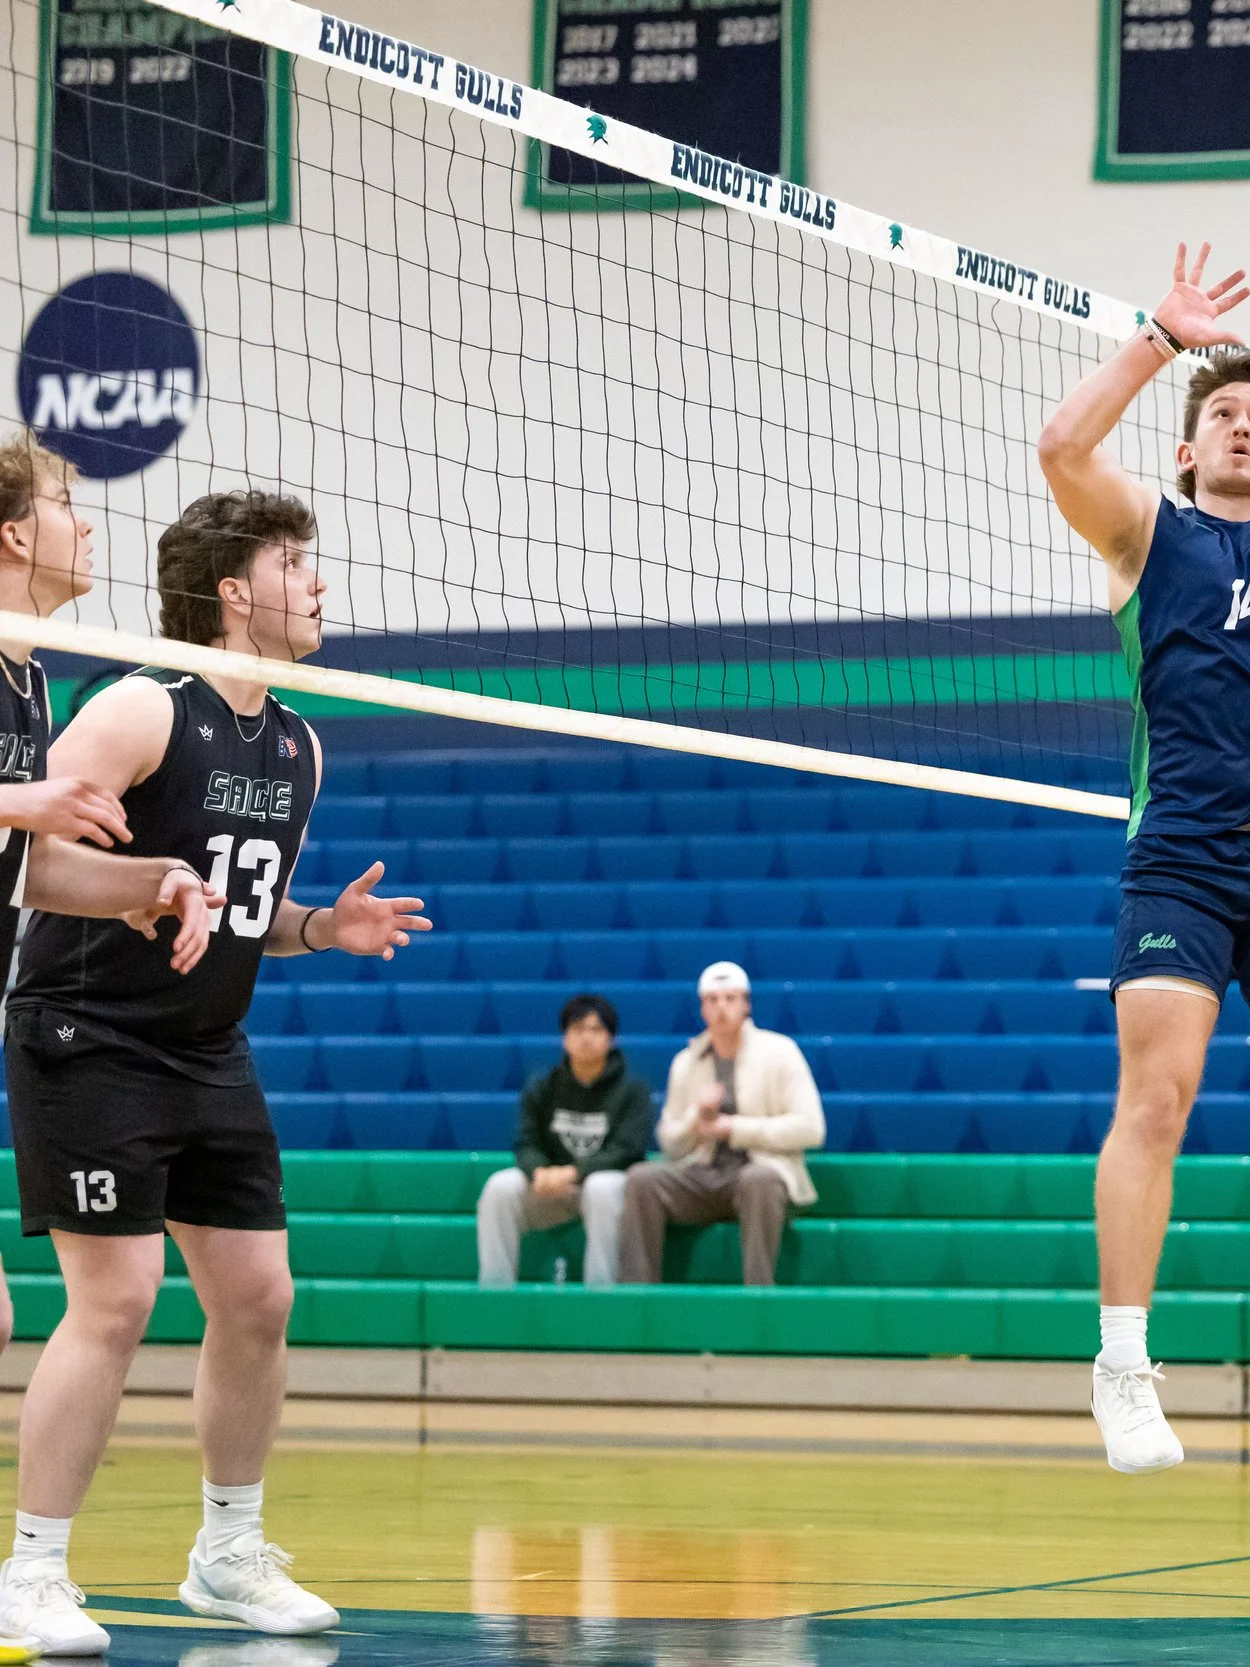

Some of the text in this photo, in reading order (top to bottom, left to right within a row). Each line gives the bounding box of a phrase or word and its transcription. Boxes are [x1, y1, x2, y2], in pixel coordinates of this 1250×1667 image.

[634, 20, 697, 51] 2021
[1123, 20, 1195, 51] 2022
[130, 55, 191, 84] 2022
[318, 14, 523, 120] ENDICOTT GULLS
[557, 53, 698, 87] 2023 2024
[671, 144, 837, 231] ENDICOTT GULLS
[955, 245, 1091, 319] ENDICOTT GULLS
[32, 368, 195, 431] NCAA
[203, 770, 293, 823] SAGE
[205, 833, 283, 939] 13
[1138, 933, 1177, 954] Gulls
[69, 1170, 118, 1213] 13
